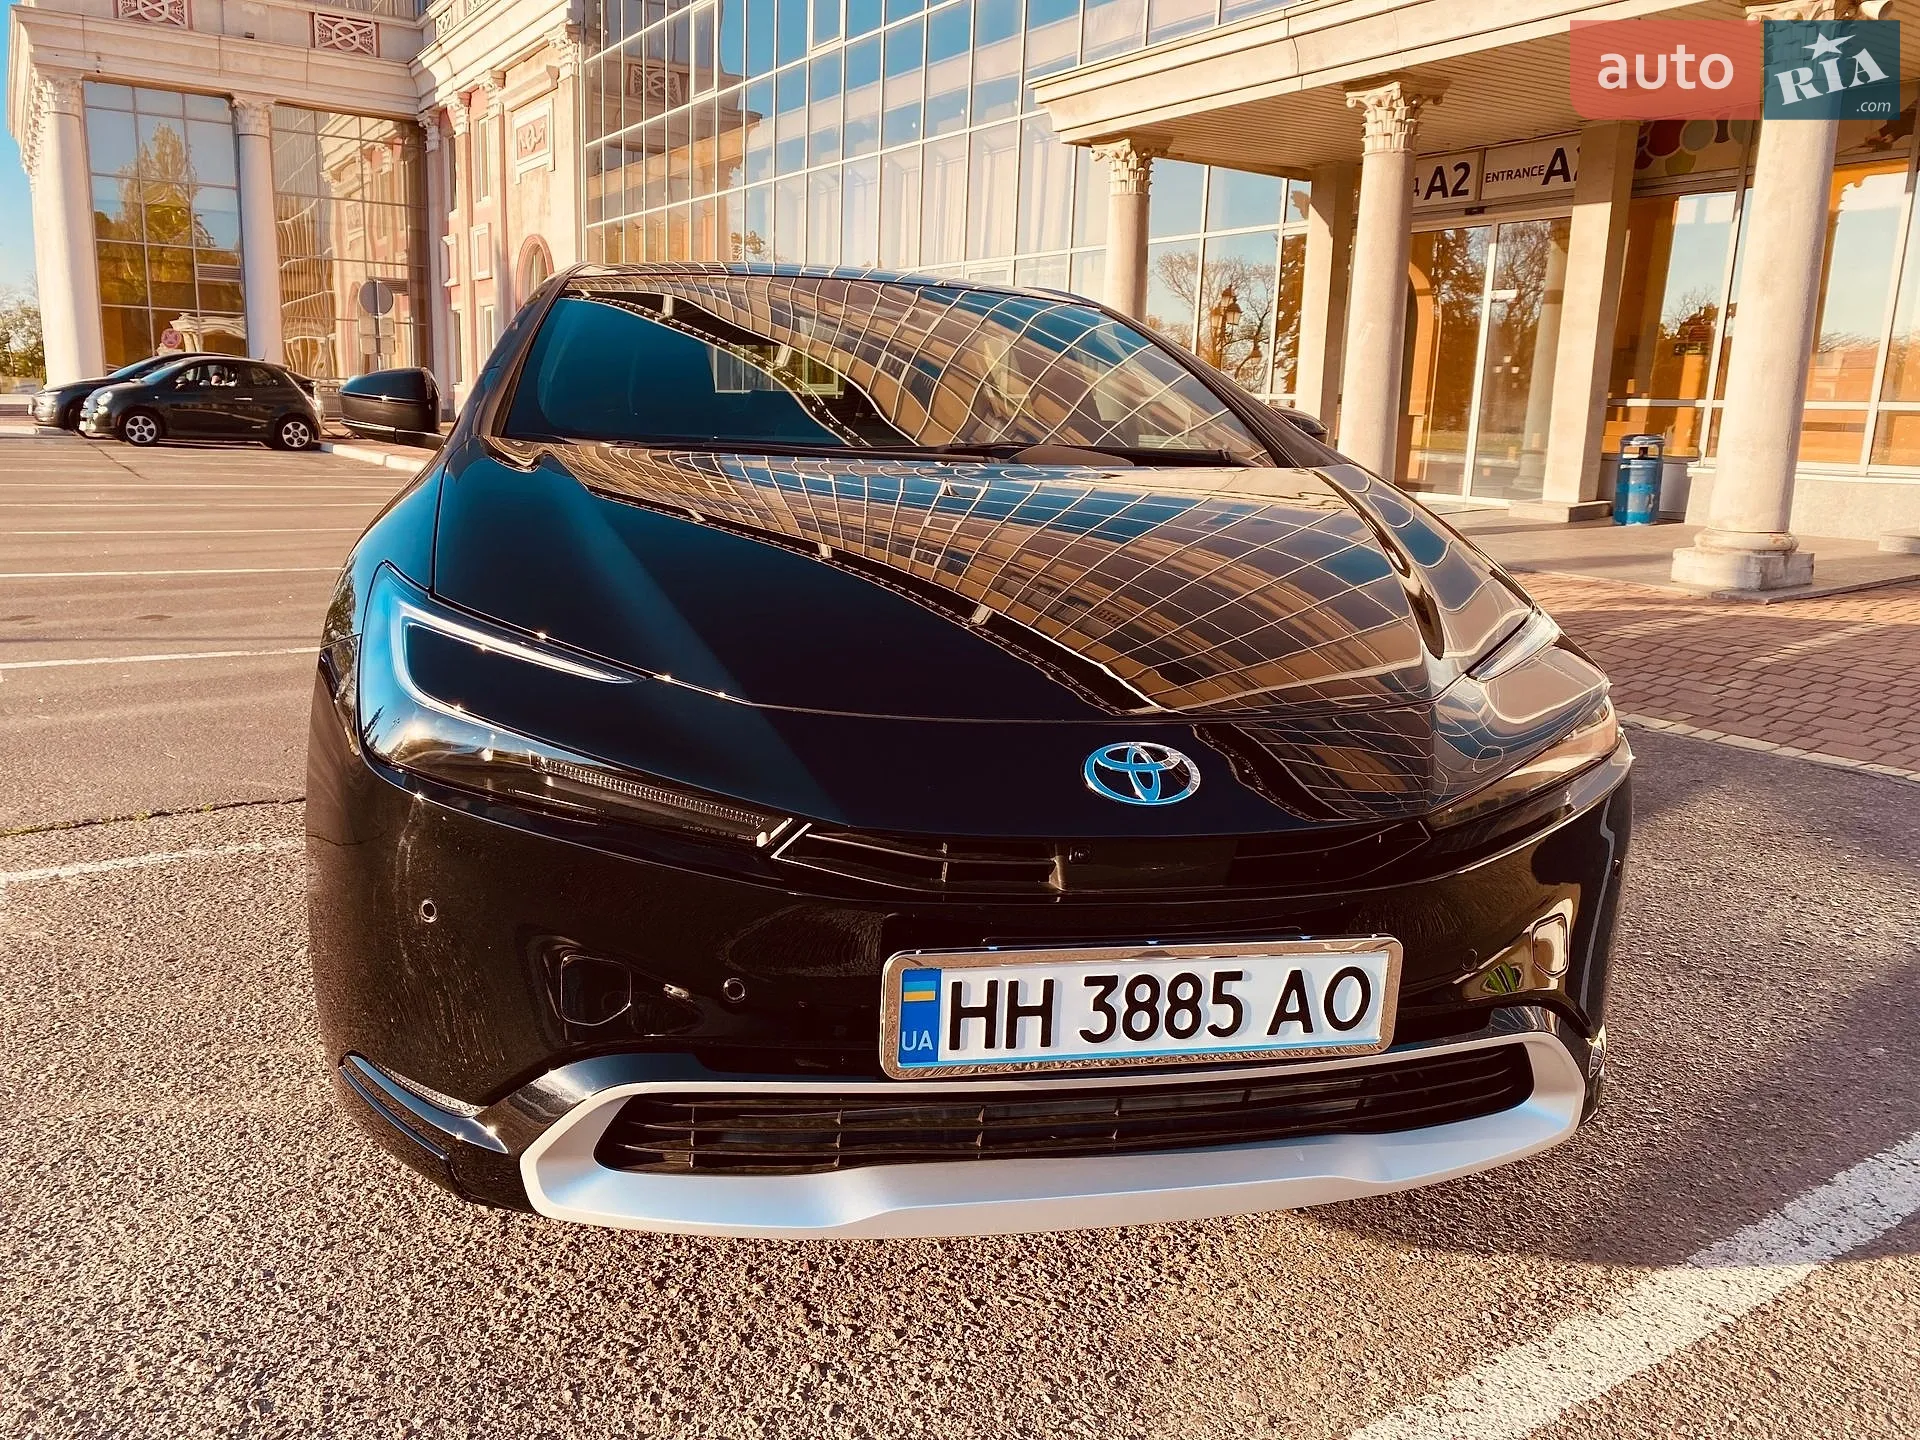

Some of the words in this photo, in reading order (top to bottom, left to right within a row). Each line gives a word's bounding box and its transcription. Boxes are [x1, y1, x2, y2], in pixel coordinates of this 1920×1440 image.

[1423, 161, 1471, 201] A2
[1485, 164, 1545, 184] ENTRANCE
[1541, 146, 1581, 186] A
[948, 977, 1055, 1051] HH
[1079, 970, 1245, 1044] 3885
[1266, 965, 1372, 1036] AO
[901, 1030, 934, 1052] UA
